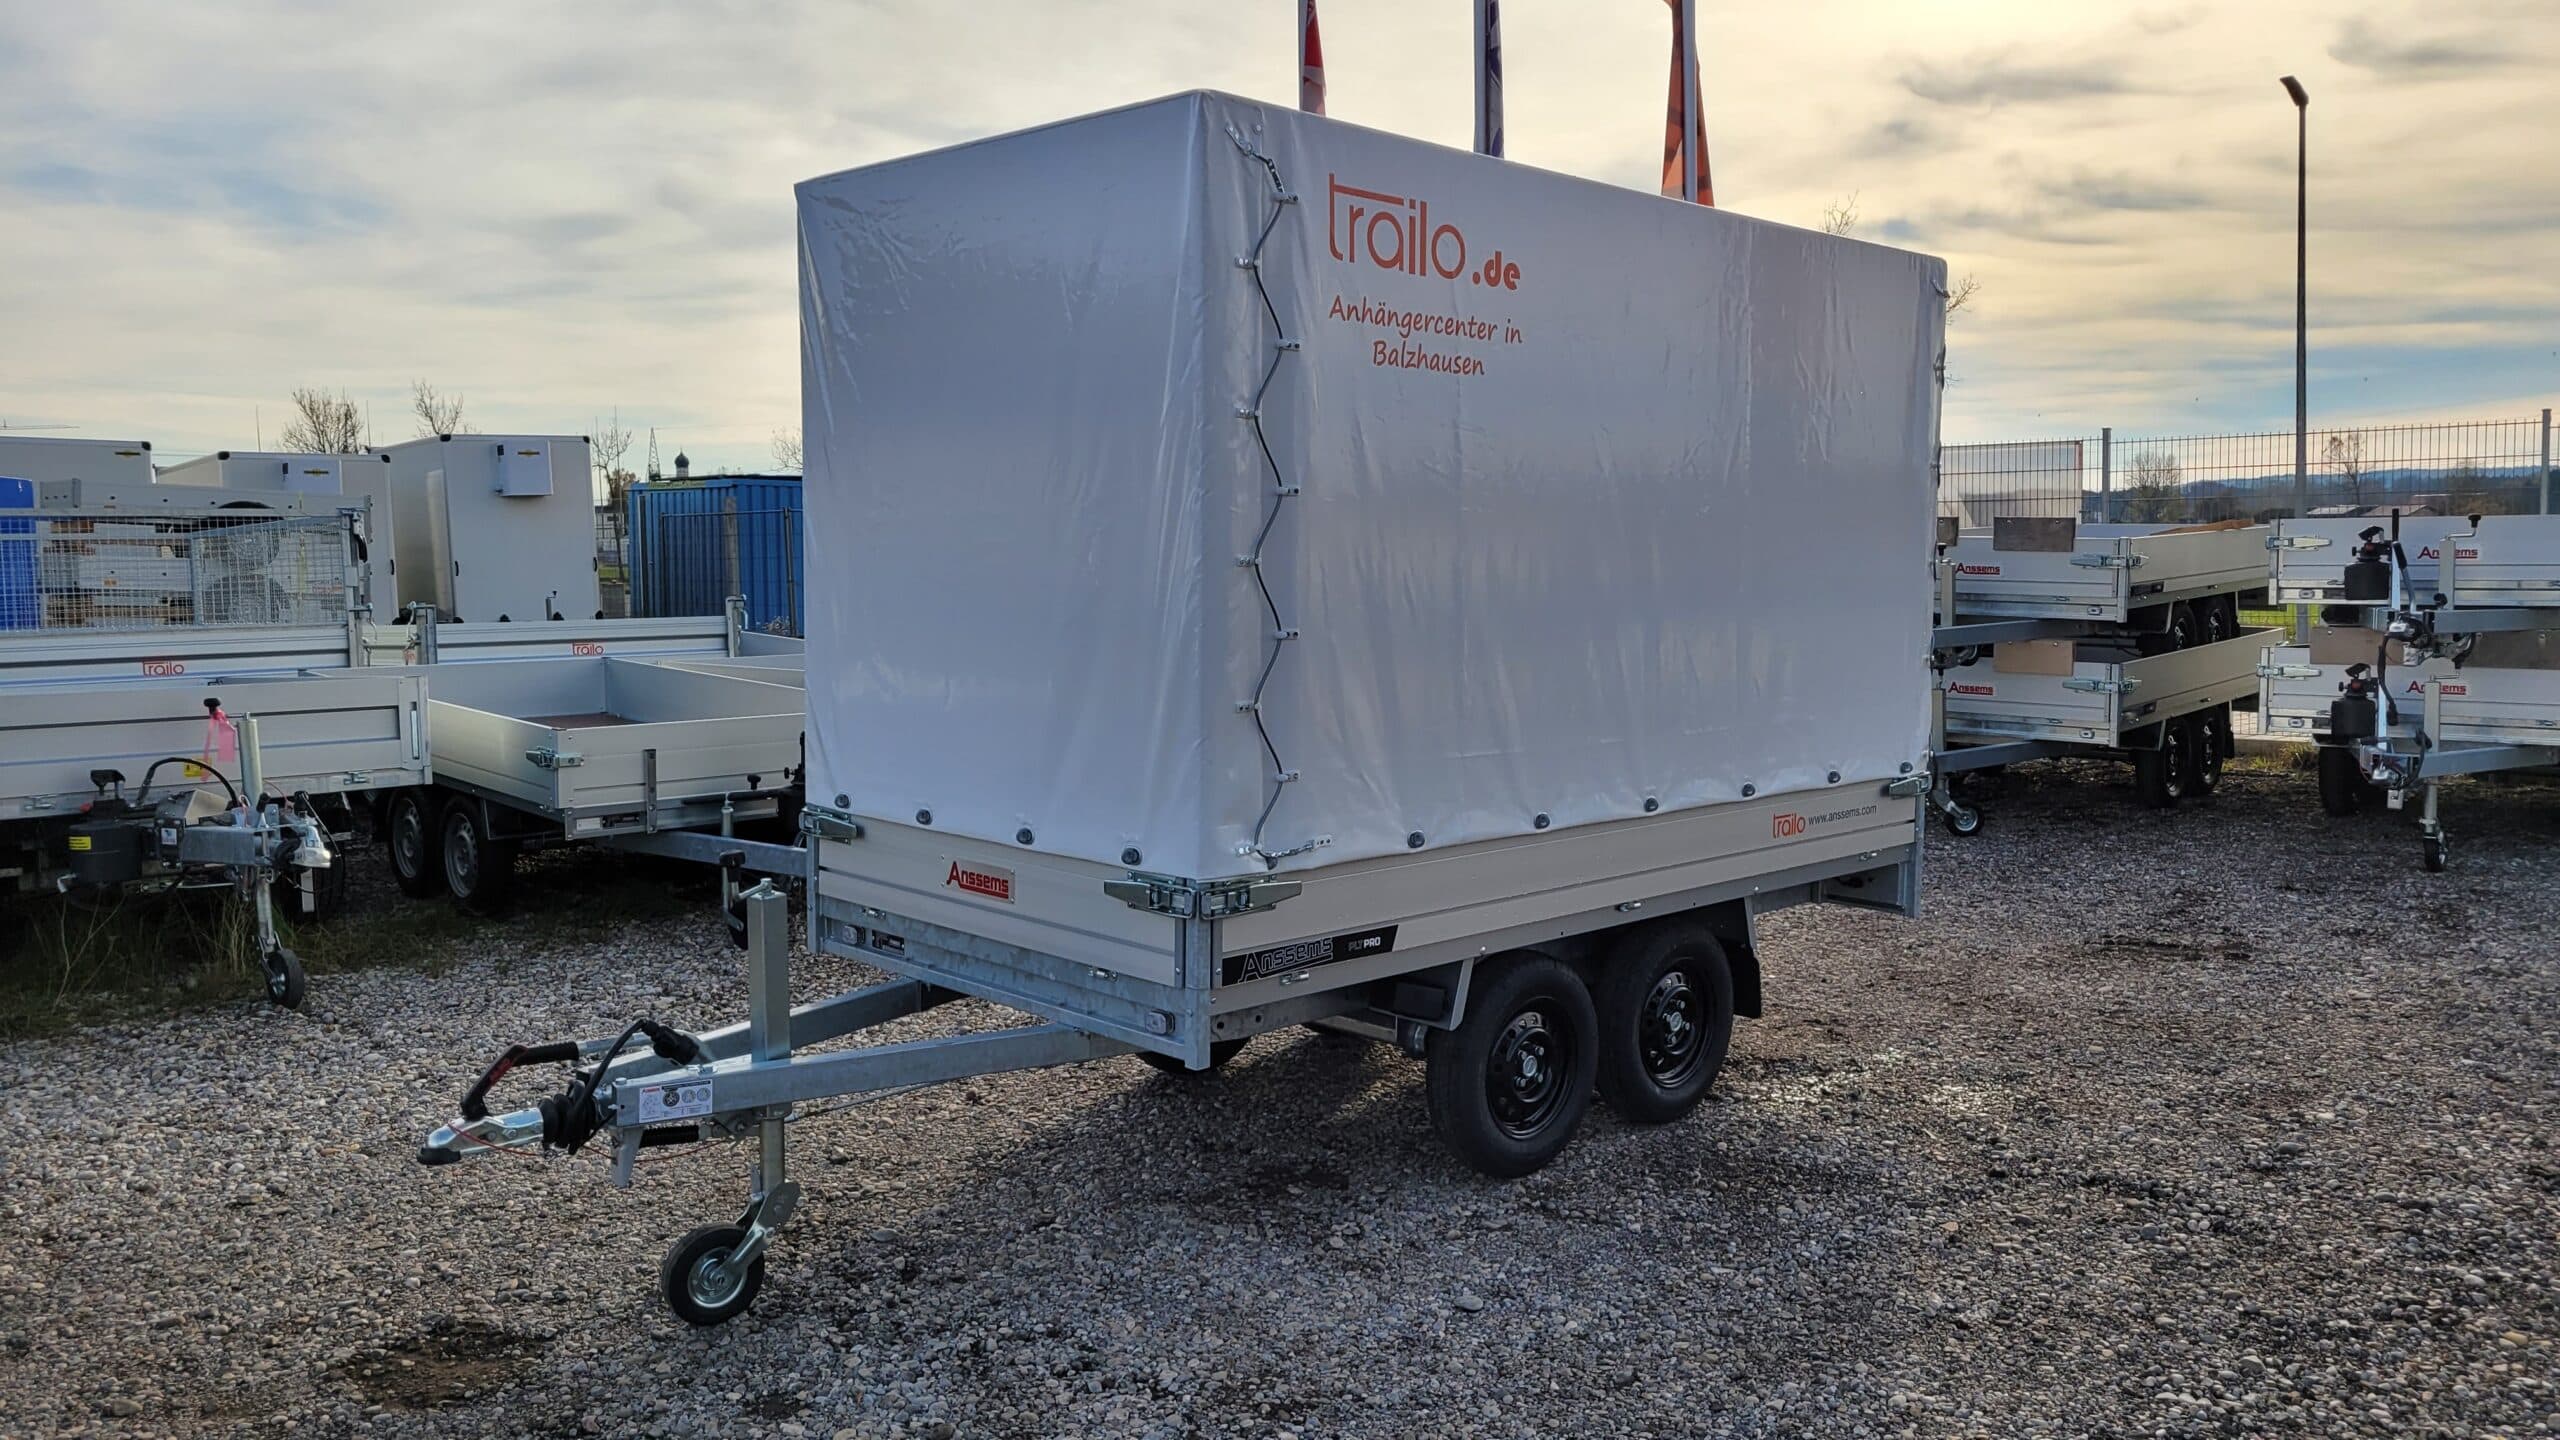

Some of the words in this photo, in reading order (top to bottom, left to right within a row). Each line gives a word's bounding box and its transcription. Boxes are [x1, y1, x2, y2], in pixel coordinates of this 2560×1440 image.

[1329, 295, 1498, 341] Anhängercenter
[1504, 318, 1523, 344] in
[1373, 340, 1485, 376] Balzhausen
[1955, 562, 2000, 575] Anssems
[2417, 546, 2478, 559] Anems
[1948, 681, 1994, 696] Anssems
[2406, 681, 2466, 695] Anems
[1773, 813, 1806, 839] trailo
[1808, 804, 1877, 826] www.anssems.com
[946, 860, 1009, 899] Anssems
[1238, 937, 1334, 984] Anssems
